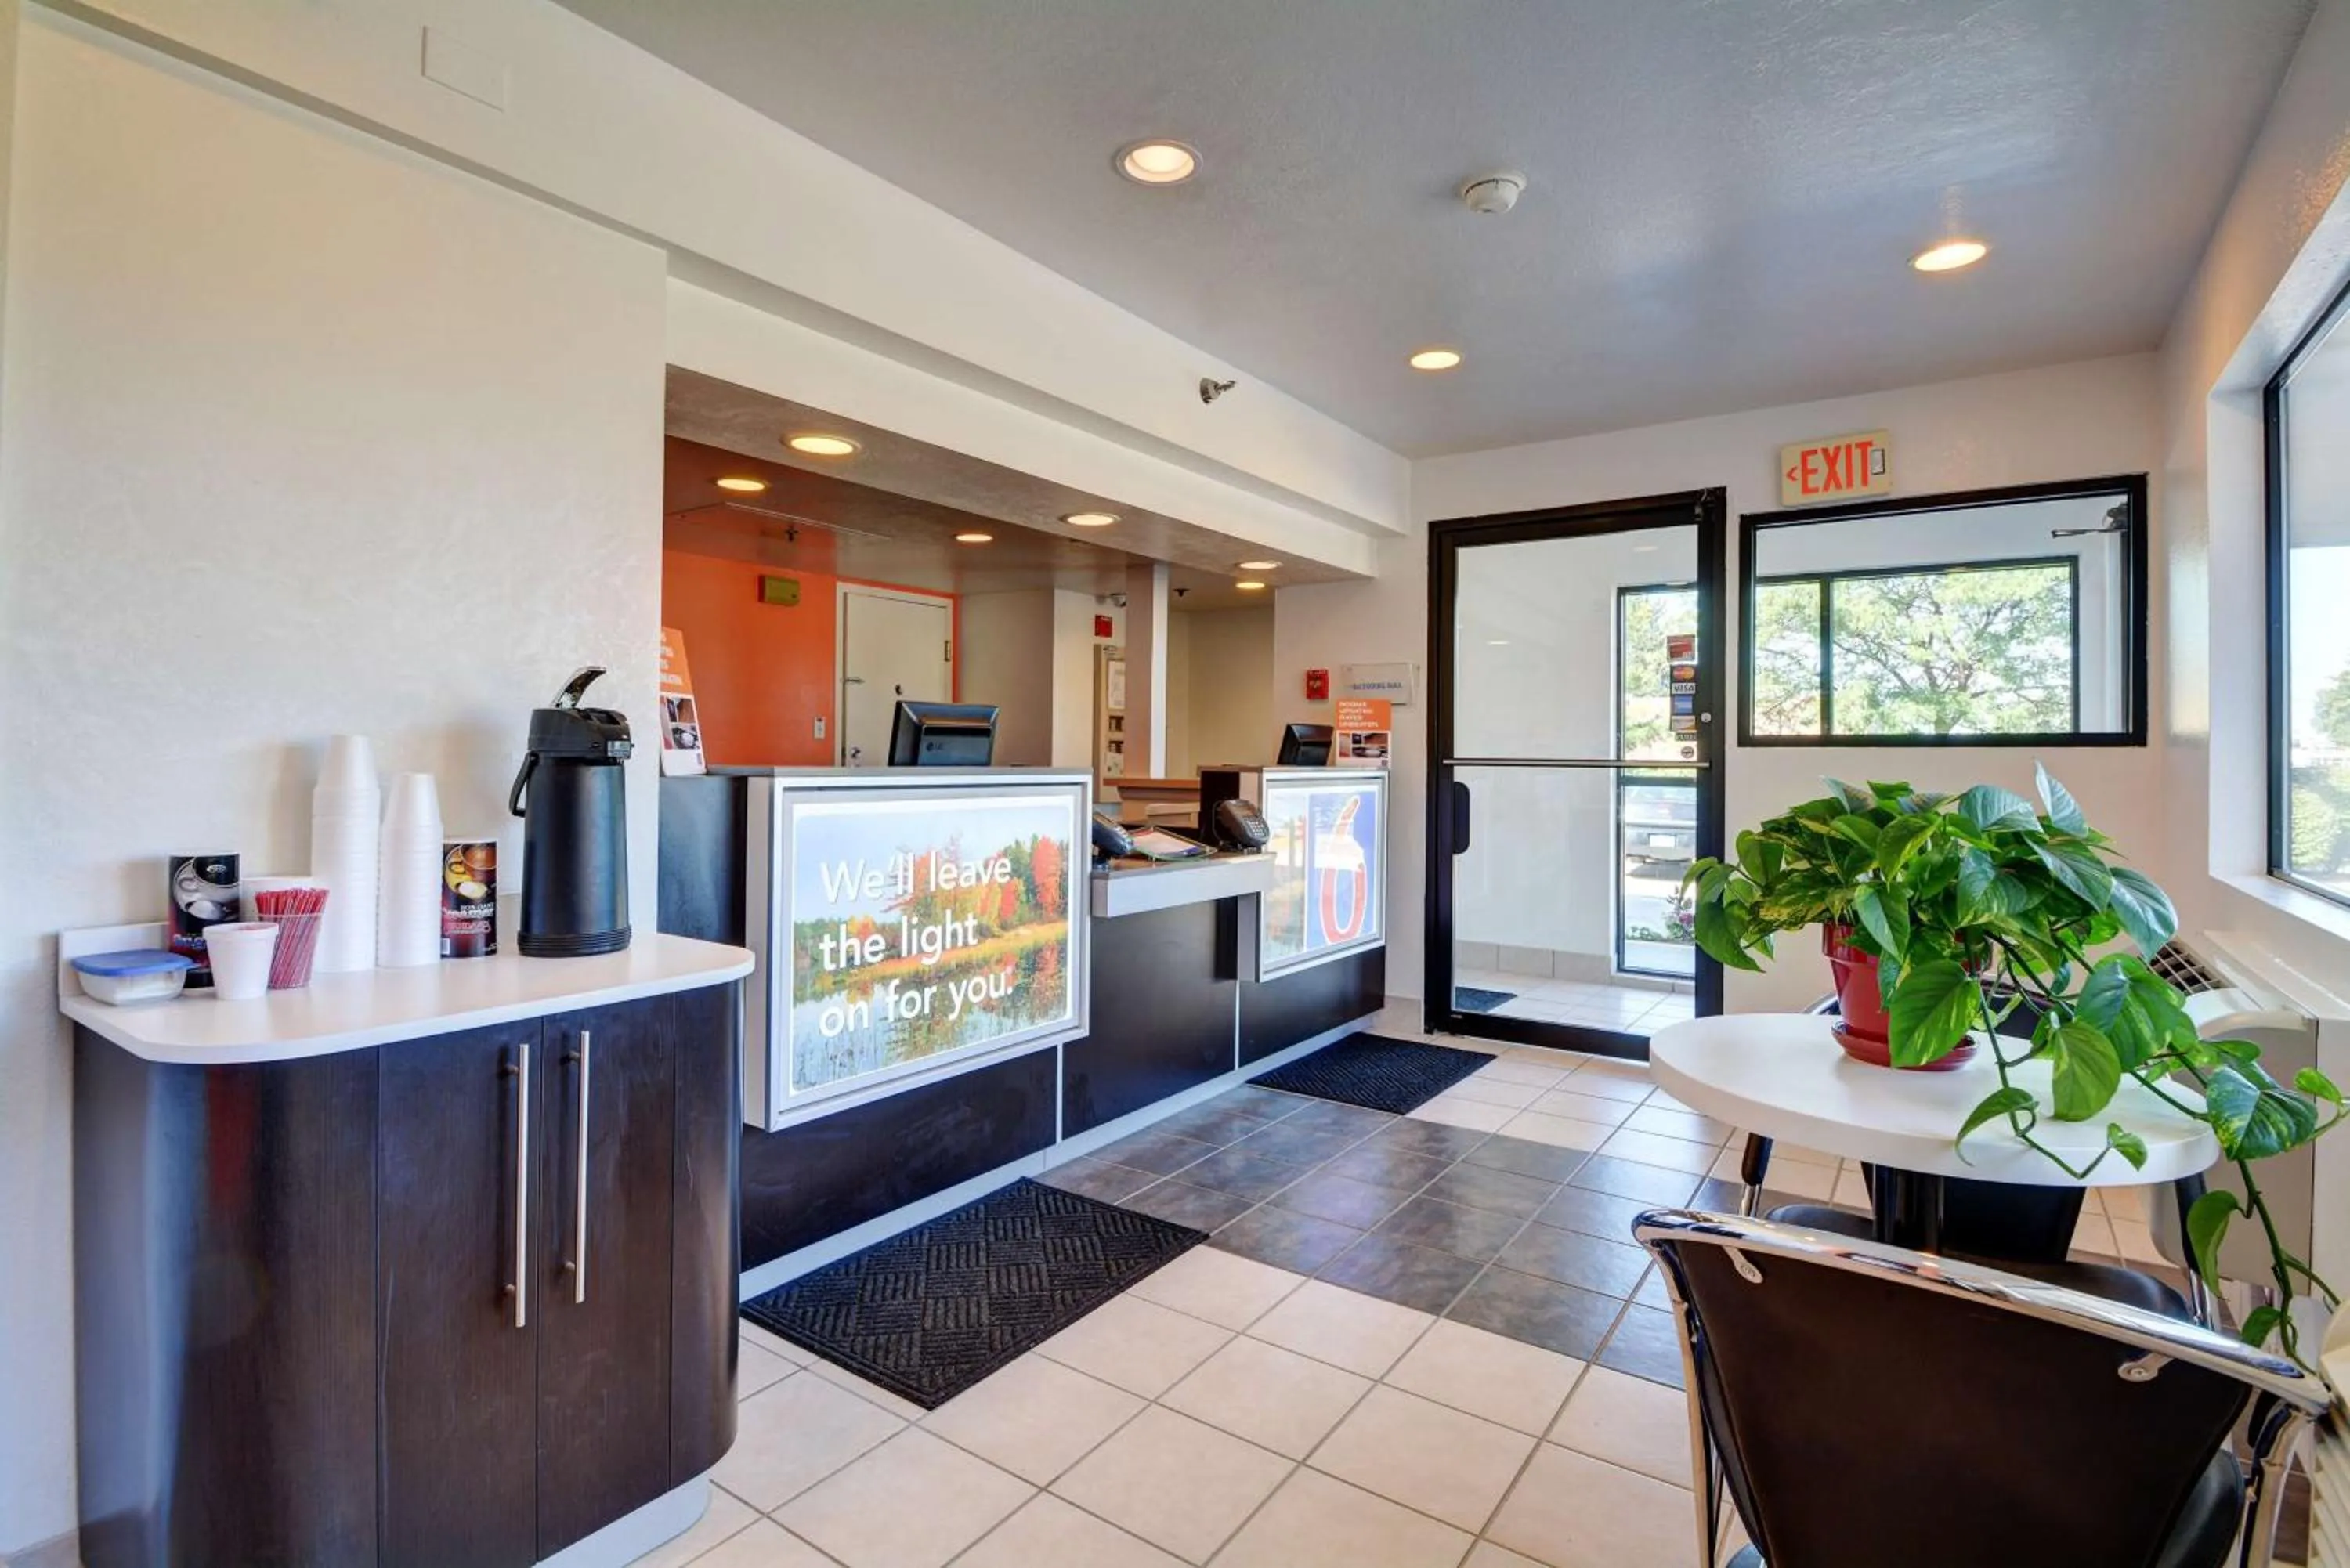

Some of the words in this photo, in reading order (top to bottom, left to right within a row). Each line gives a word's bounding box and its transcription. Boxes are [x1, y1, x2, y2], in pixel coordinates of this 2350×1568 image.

[1801, 441, 1873, 495] EXIT
[1674, 684, 1694, 693] VISA
[821, 851, 915, 903] We'll
[929, 850, 1012, 892] leave
[819, 923, 886, 972] the
[901, 909, 978, 966] light
[819, 999, 870, 1038] on
[884, 978, 938, 1023] for
[948, 971, 1014, 1020] you.
